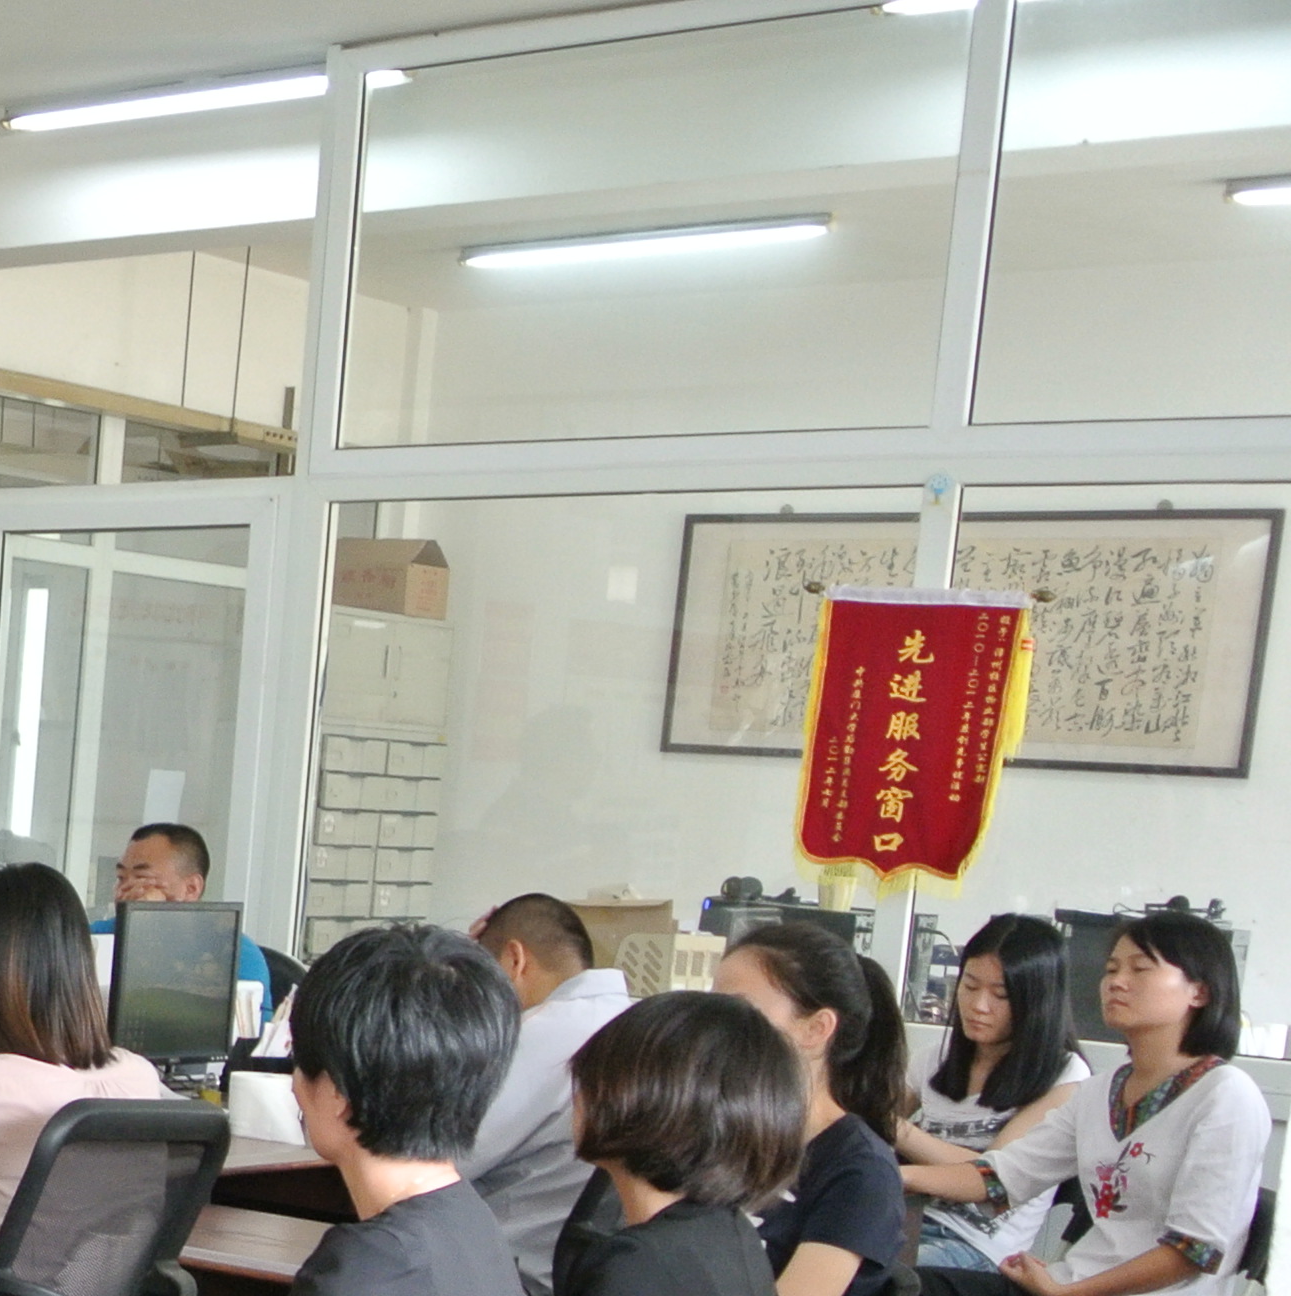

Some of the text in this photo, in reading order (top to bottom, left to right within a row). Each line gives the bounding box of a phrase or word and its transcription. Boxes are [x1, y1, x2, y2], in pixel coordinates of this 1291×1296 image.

[872, 629, 935, 852] 先进服务窗口
